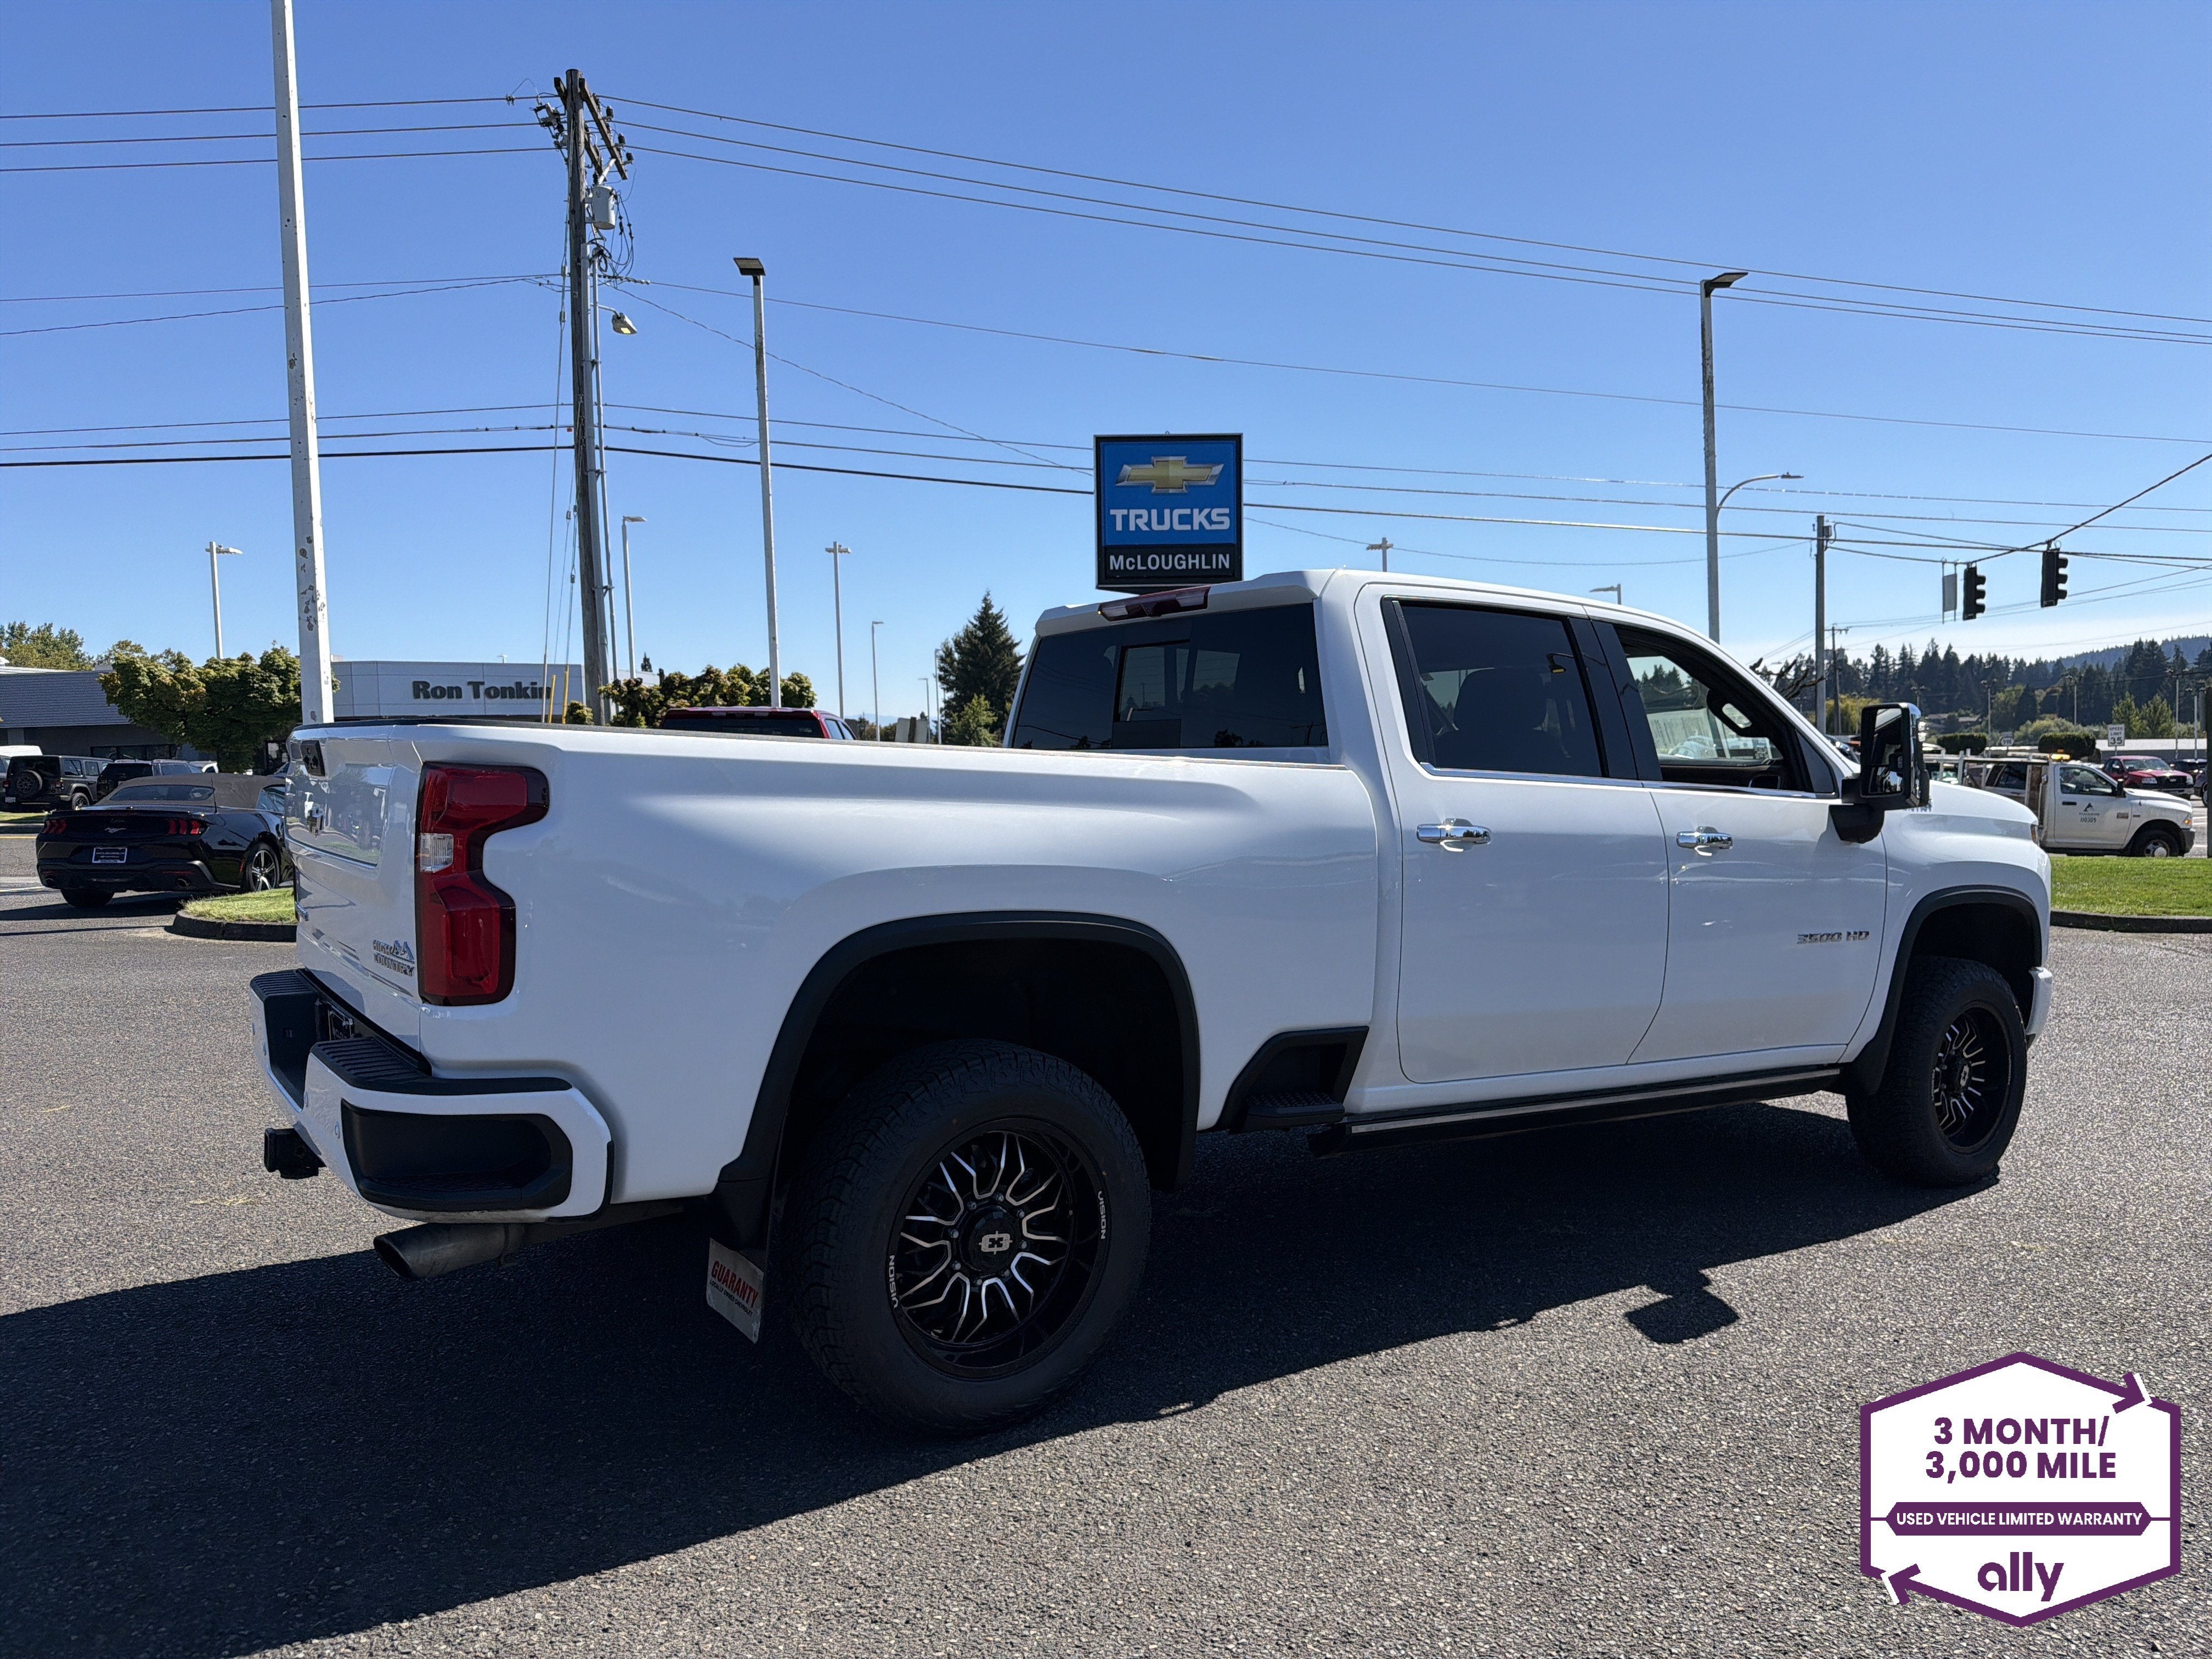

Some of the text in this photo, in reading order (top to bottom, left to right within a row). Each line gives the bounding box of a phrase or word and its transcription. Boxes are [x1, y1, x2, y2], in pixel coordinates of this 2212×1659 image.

[1110, 508, 1230, 531] TRUCKS
[1110, 554, 1230, 571] McLOUGHLIN
[413, 681, 551, 699] Ron Tonkin
[2110, 737, 2122, 745] 35
[1797, 930, 1870, 944] 3500 HD
[374, 952, 414, 977] COUNTRY
[1098, 1190, 1107, 1239] VISION
[709, 1279, 724, 1293] LOCALLY
[711, 1260, 759, 1308] GUARANTY
[889, 1255, 899, 1308] VISION
